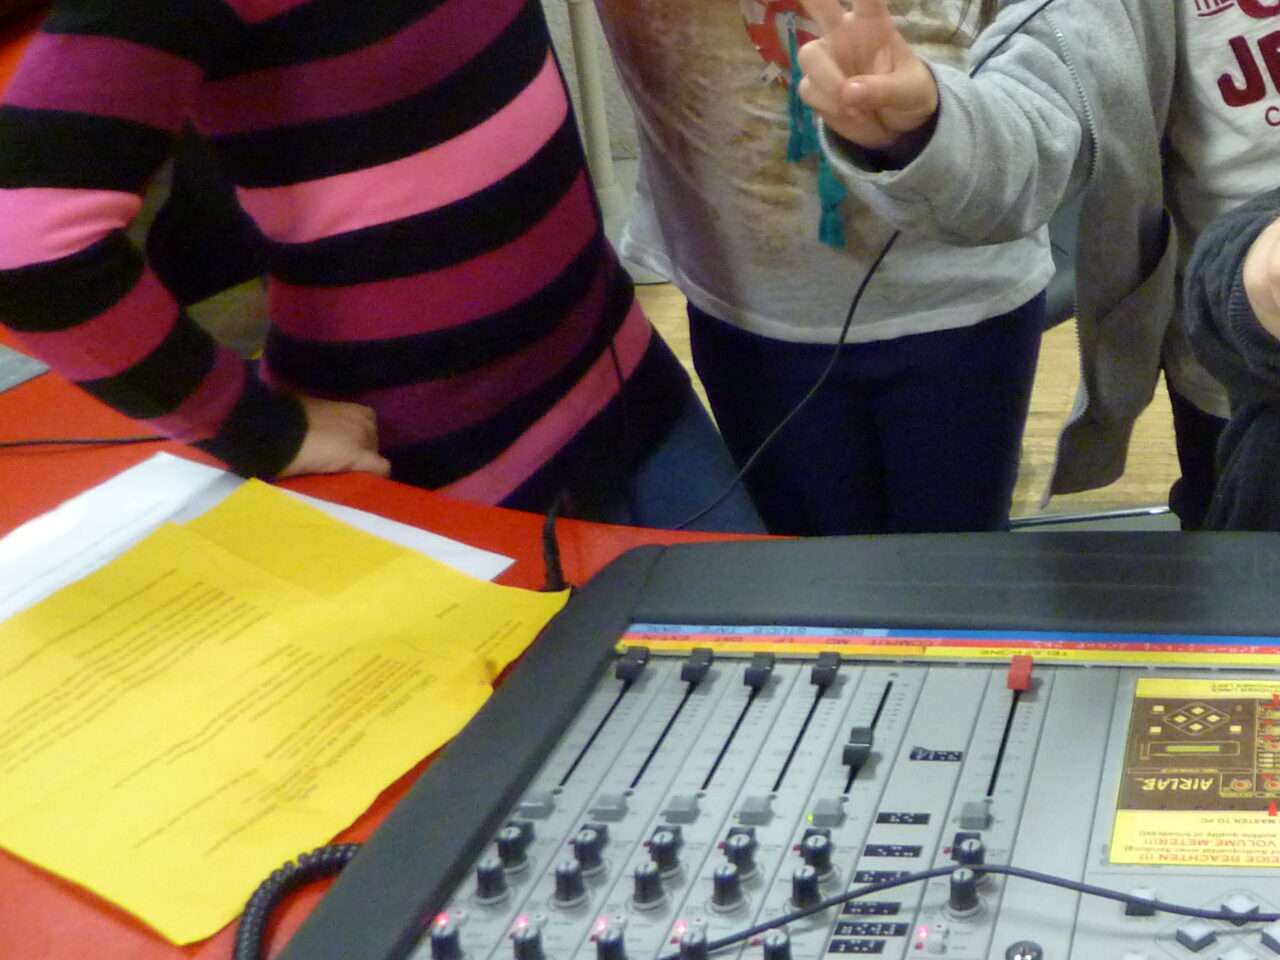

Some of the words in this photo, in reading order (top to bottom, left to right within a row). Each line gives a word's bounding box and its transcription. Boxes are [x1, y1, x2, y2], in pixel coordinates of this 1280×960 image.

[1142, 777, 1214, 791] AIRLAB
[1207, 831, 1239, 839] quality
[1158, 854, 1240, 864] BEACHTEN
